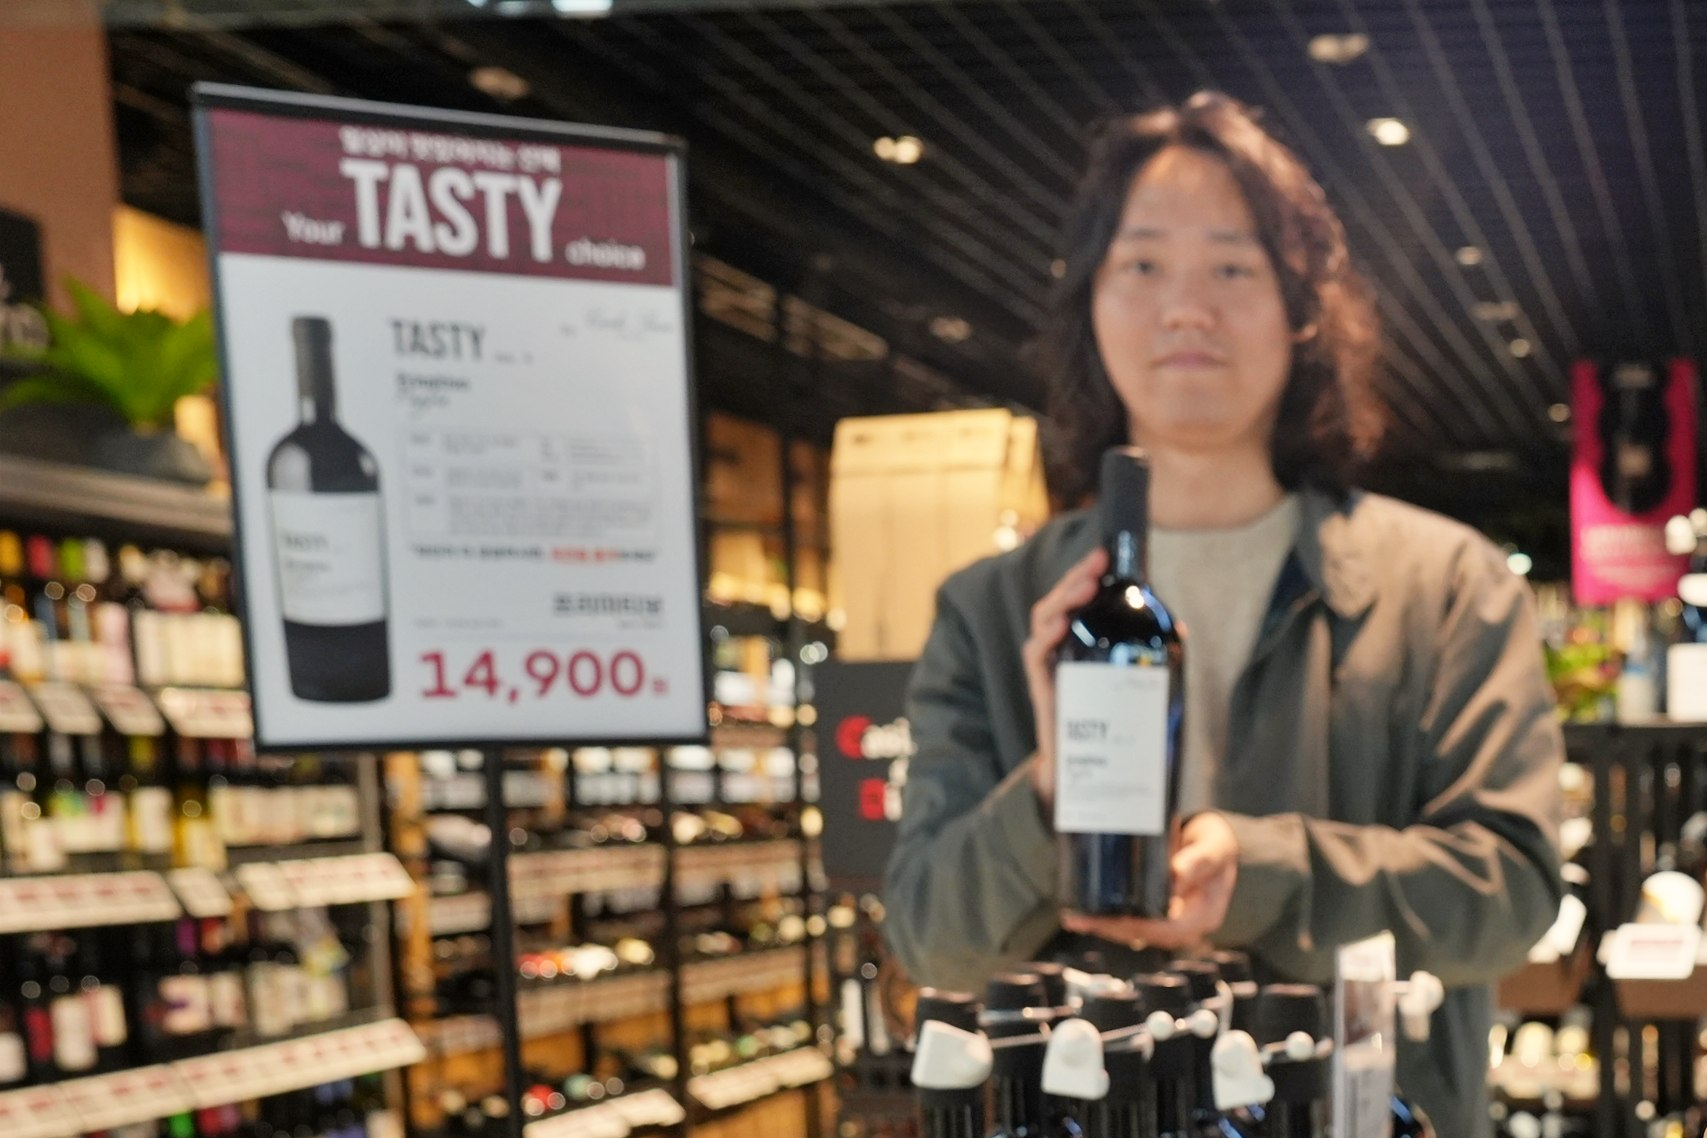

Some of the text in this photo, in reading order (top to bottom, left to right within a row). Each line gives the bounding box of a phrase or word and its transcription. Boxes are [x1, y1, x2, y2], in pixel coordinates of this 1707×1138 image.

[339, 156, 564, 264] TASTY
[564, 236, 646, 271] choice
[389, 316, 486, 361] TASTY
